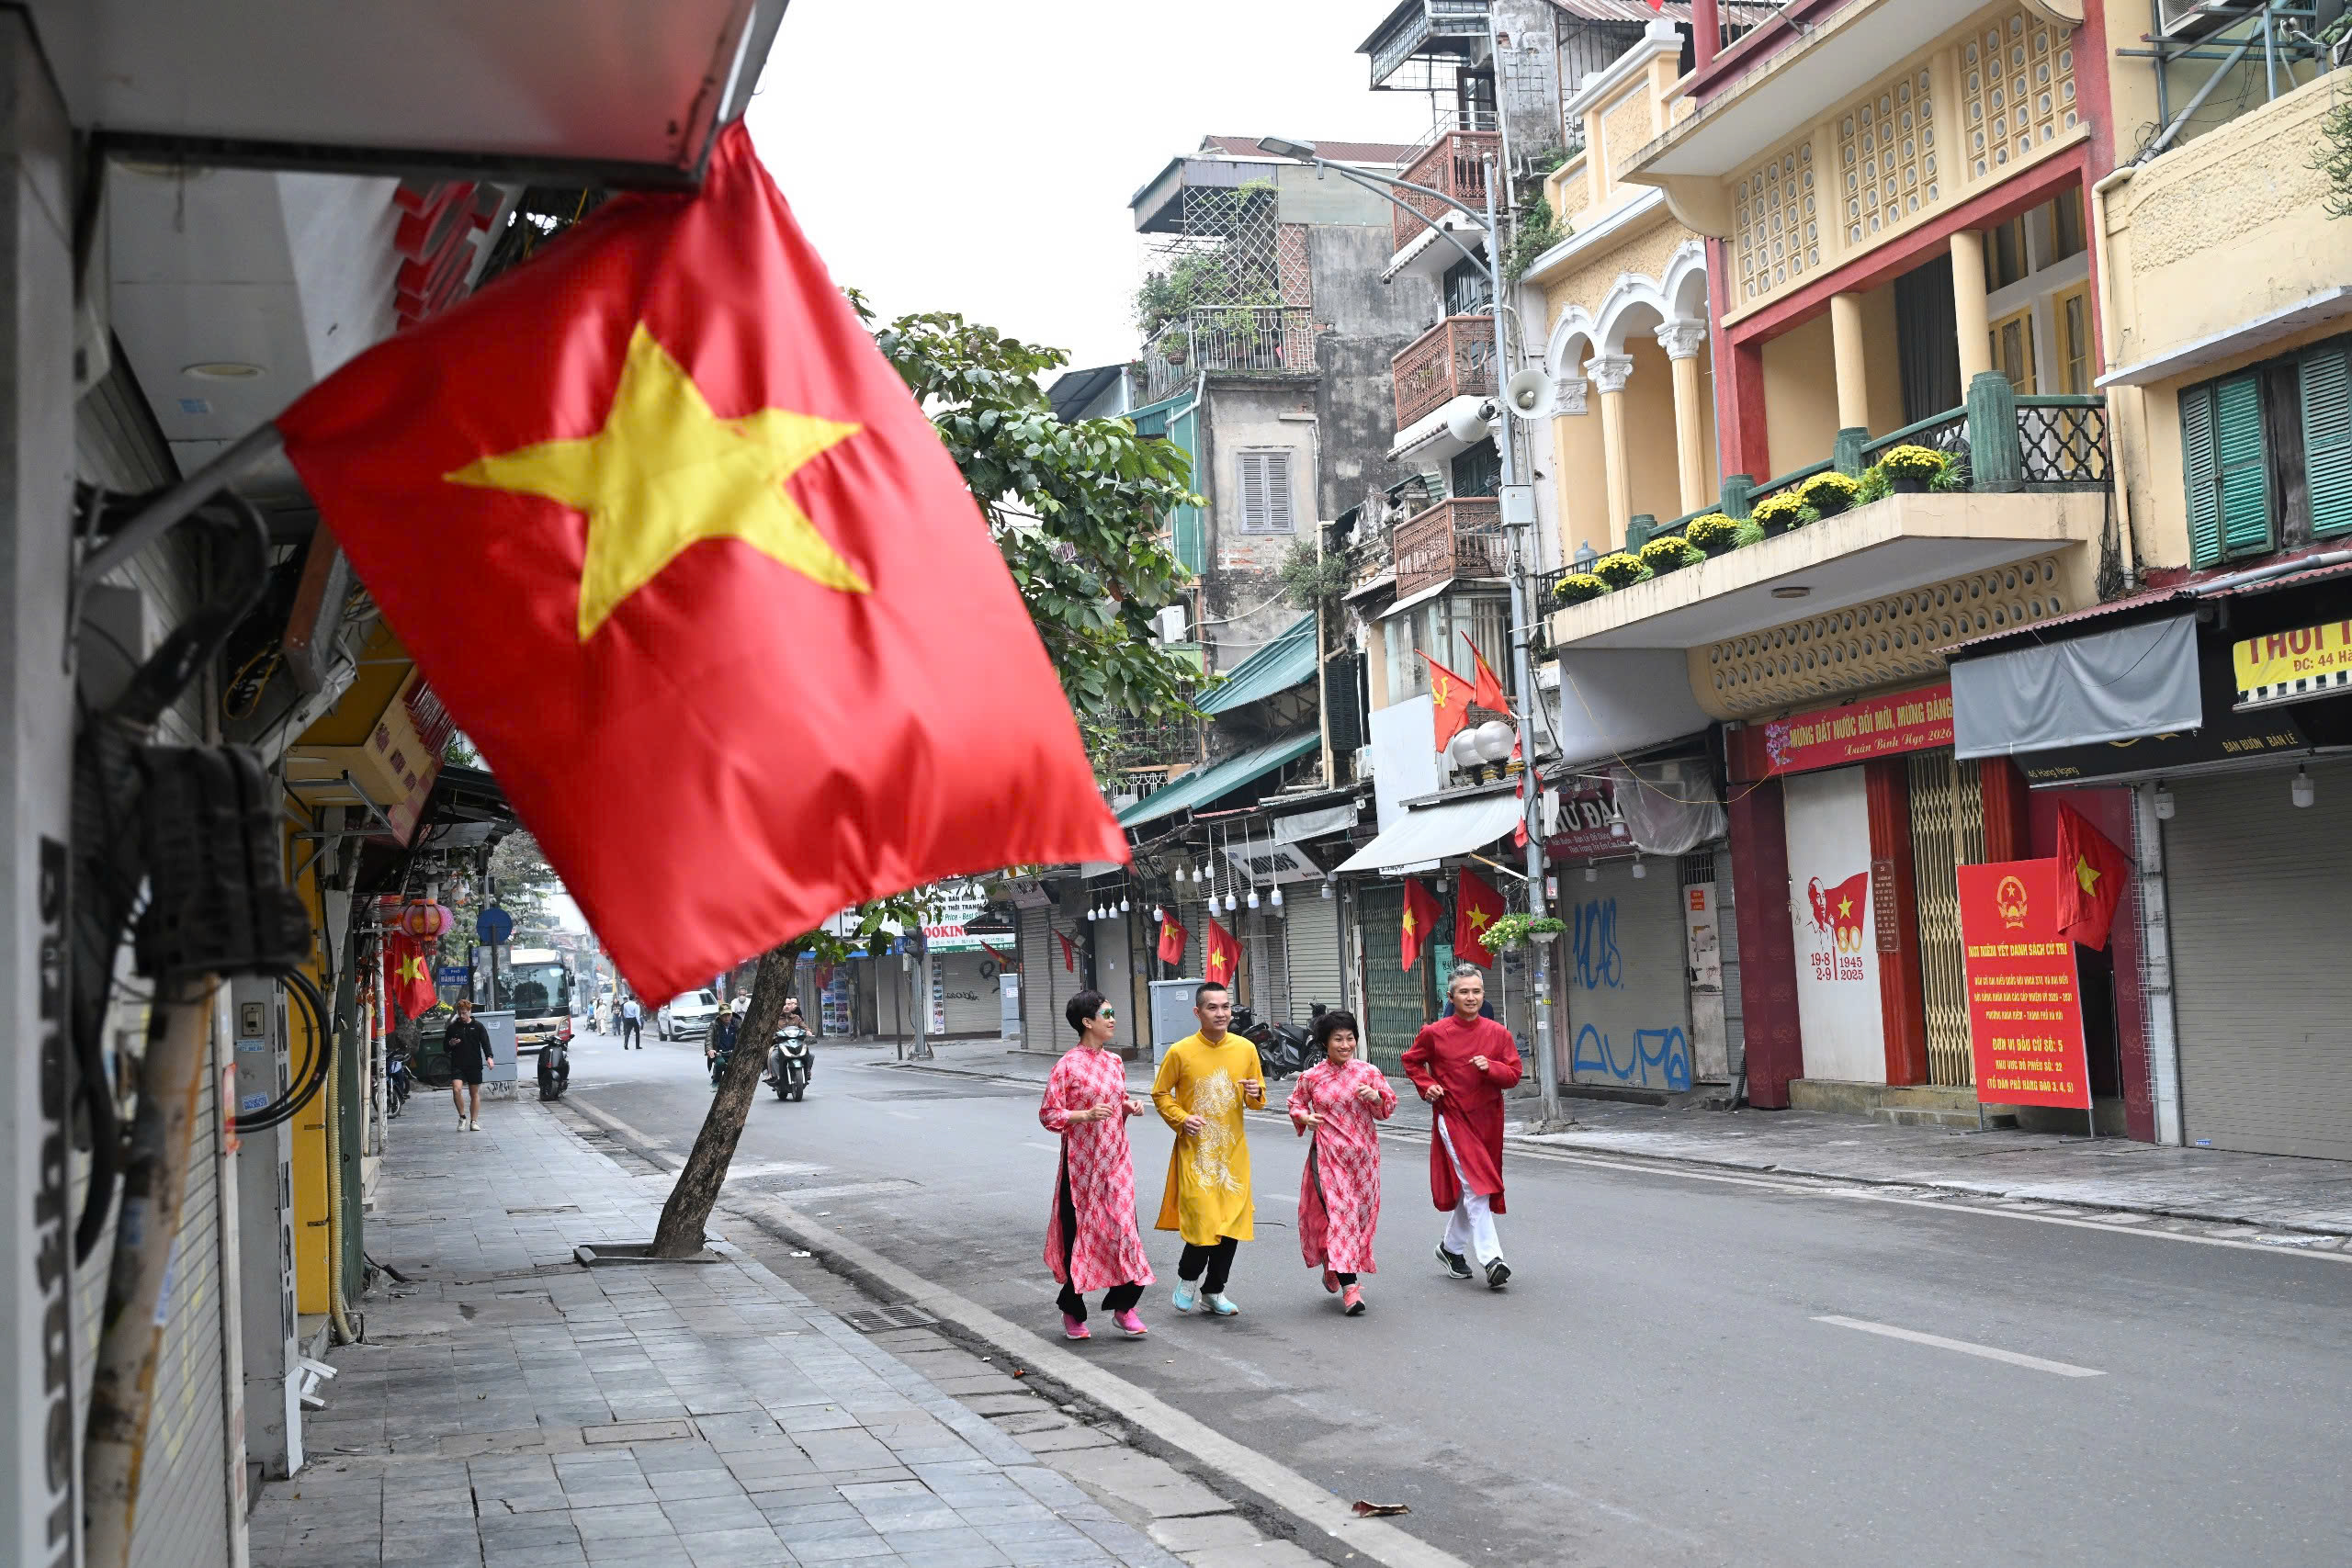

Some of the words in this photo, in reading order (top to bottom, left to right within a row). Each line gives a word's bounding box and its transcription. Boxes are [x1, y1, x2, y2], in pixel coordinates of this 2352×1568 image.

[2318, 653, 2334, 667] 44
[1928, 728, 1951, 740] 2026
[1838, 926, 1862, 953] 80
[1839, 957, 1863, 968] 1945
[1840, 970, 1864, 981] 2025
[2058, 1040, 2064, 1052] 5
[2055, 1063, 2063, 1071] 22
